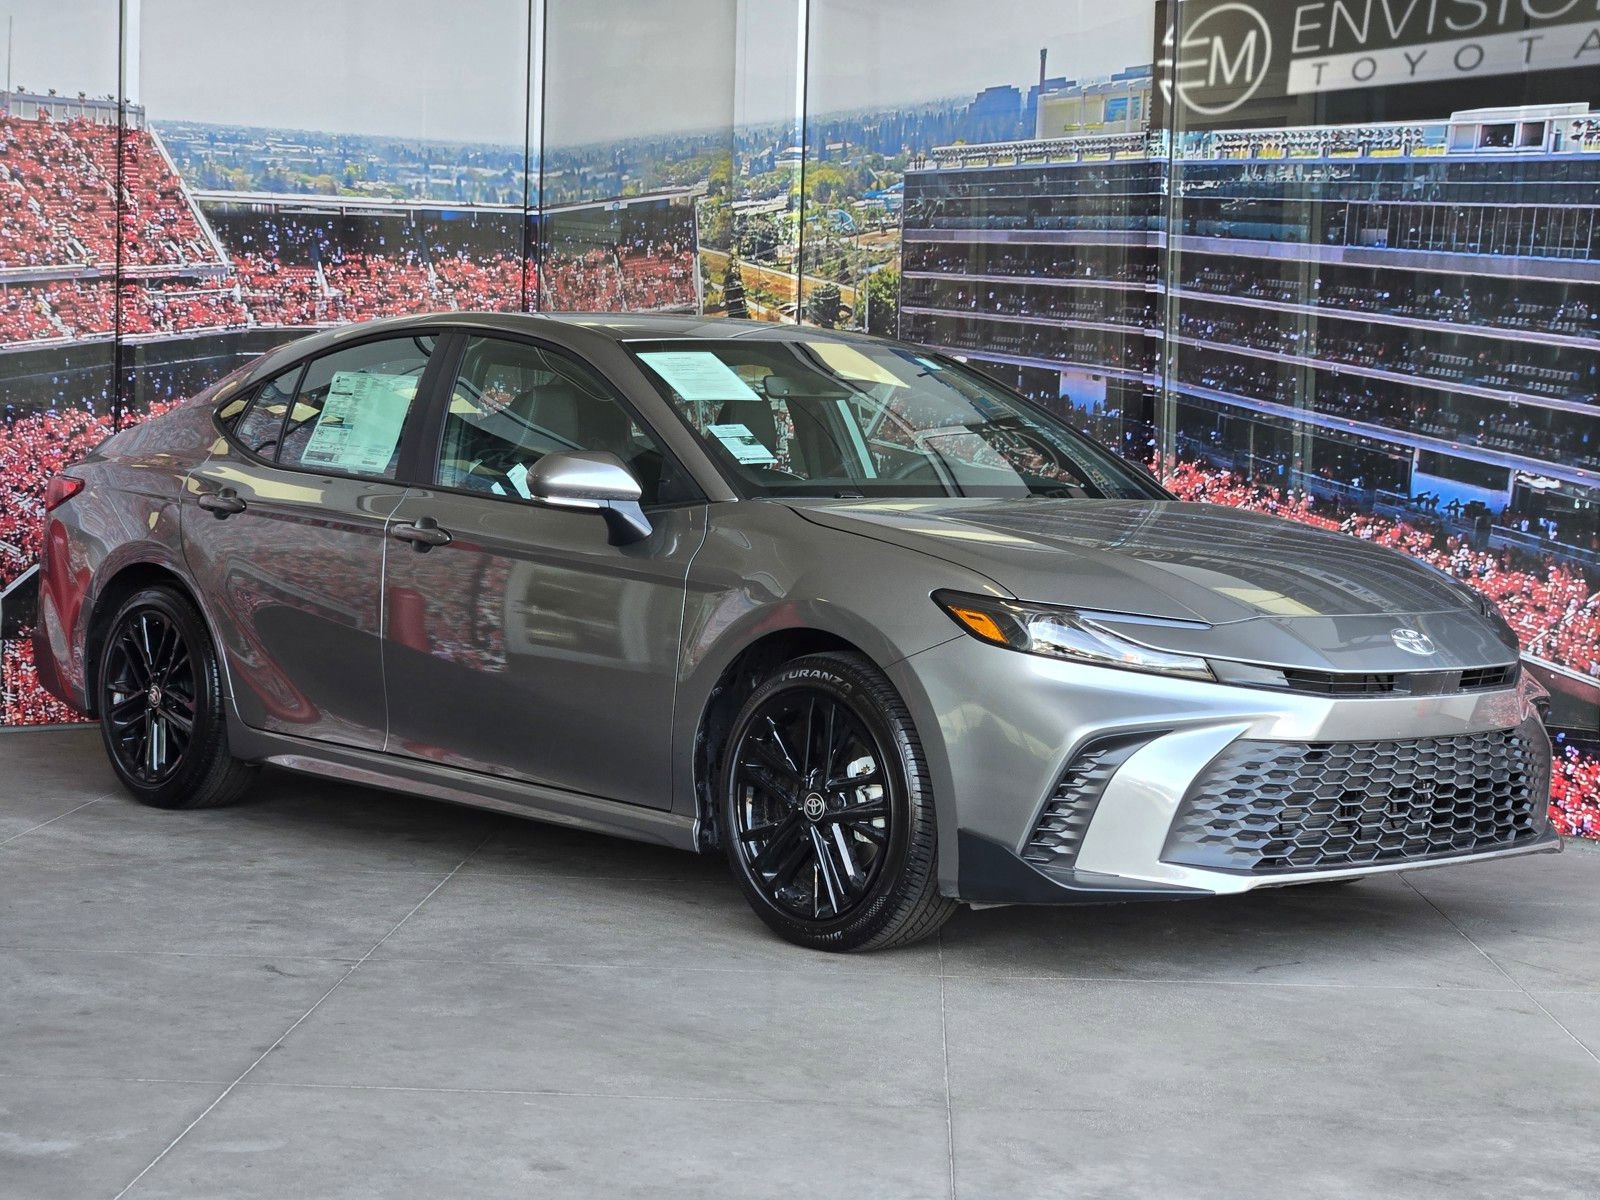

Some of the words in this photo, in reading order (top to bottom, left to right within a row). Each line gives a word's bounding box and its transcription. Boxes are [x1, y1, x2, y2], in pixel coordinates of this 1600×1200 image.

[1291, 0, 1600, 54] ENVISI
[1312, 27, 1600, 87] TOYOTA
[781, 669, 853, 696] TURANZA
